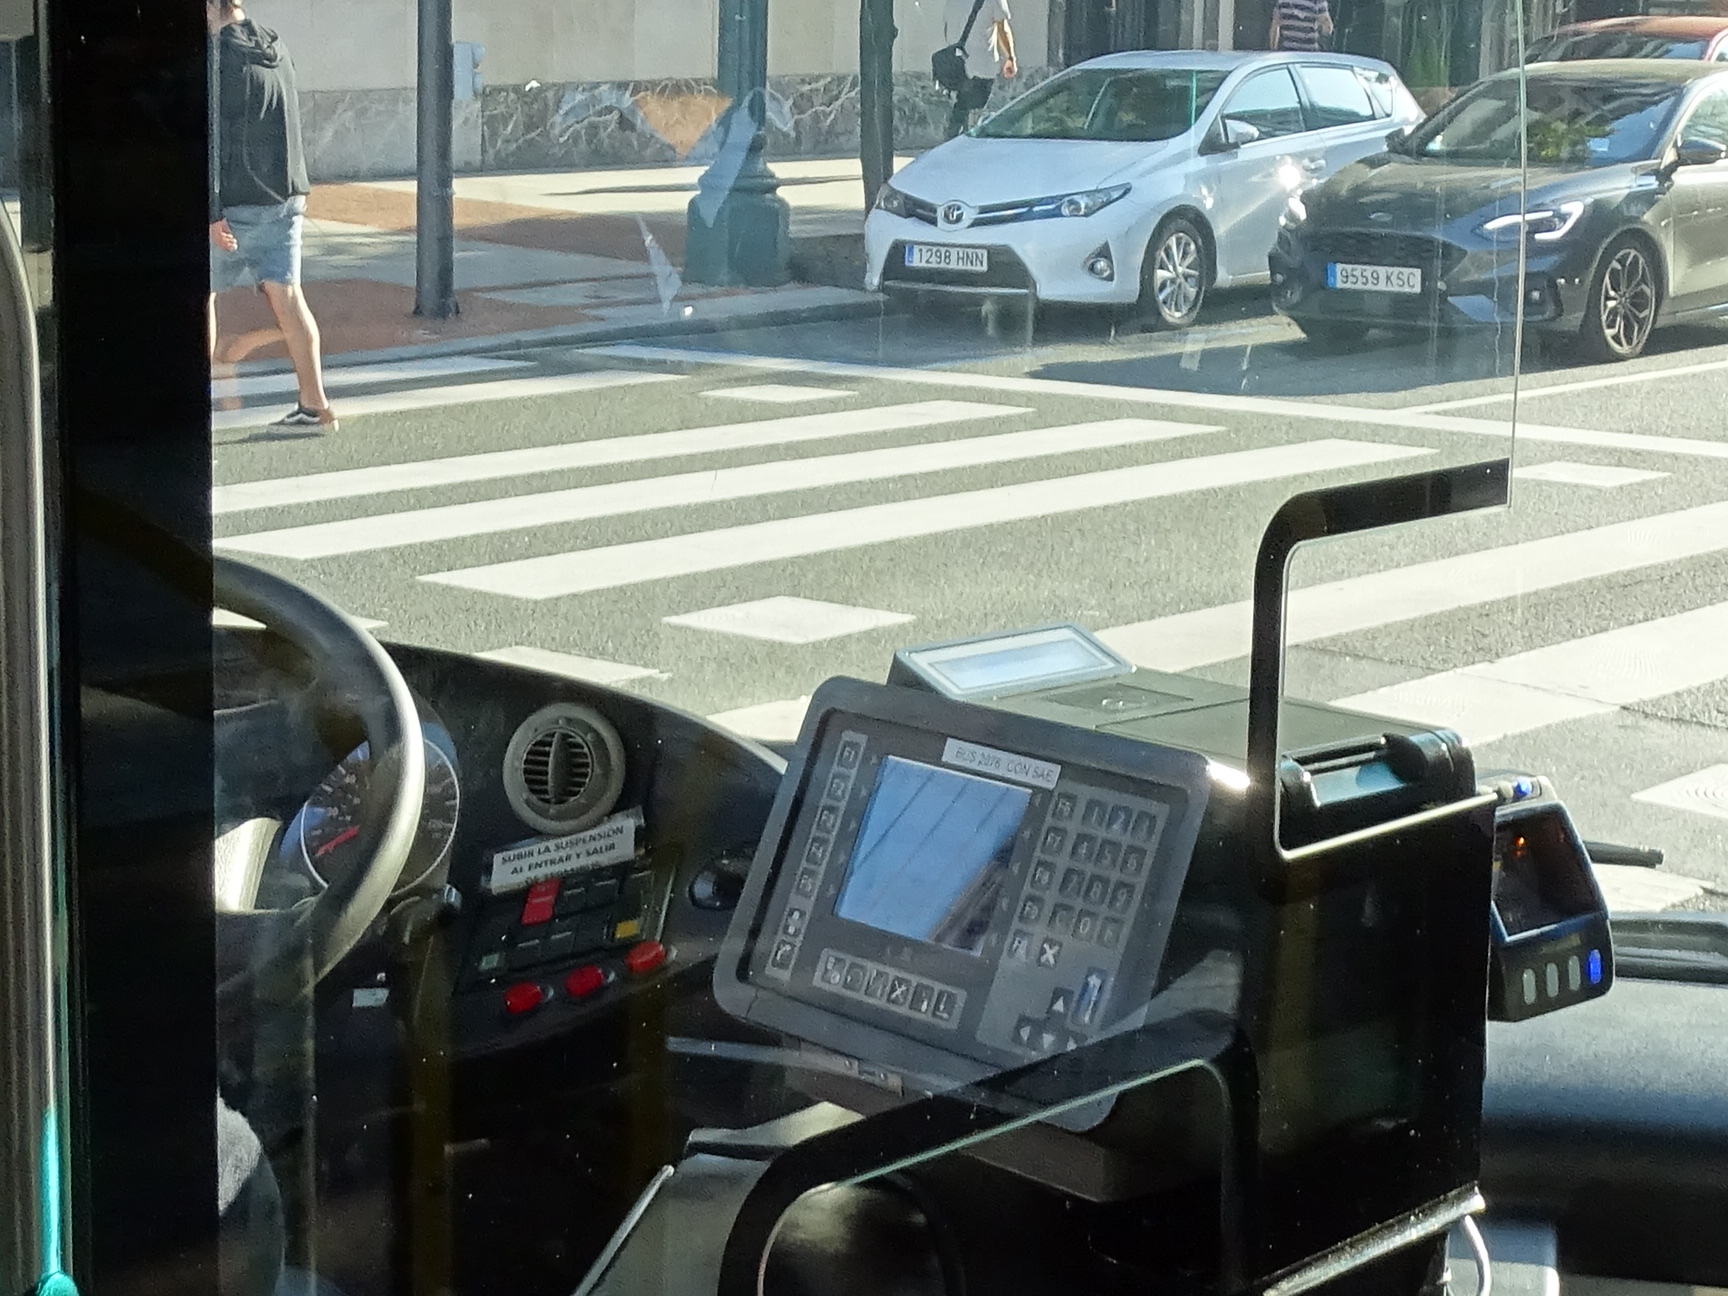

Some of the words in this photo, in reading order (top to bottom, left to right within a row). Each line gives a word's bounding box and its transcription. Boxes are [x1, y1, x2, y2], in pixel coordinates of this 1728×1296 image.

[917, 245, 952, 268] 1298
[955, 248, 988, 271] HNN
[1339, 263, 1380, 289] 9559
[1384, 266, 1418, 291] KSC
[537, 844, 552, 858] LA
[528, 853, 572, 872] ENTRAR
